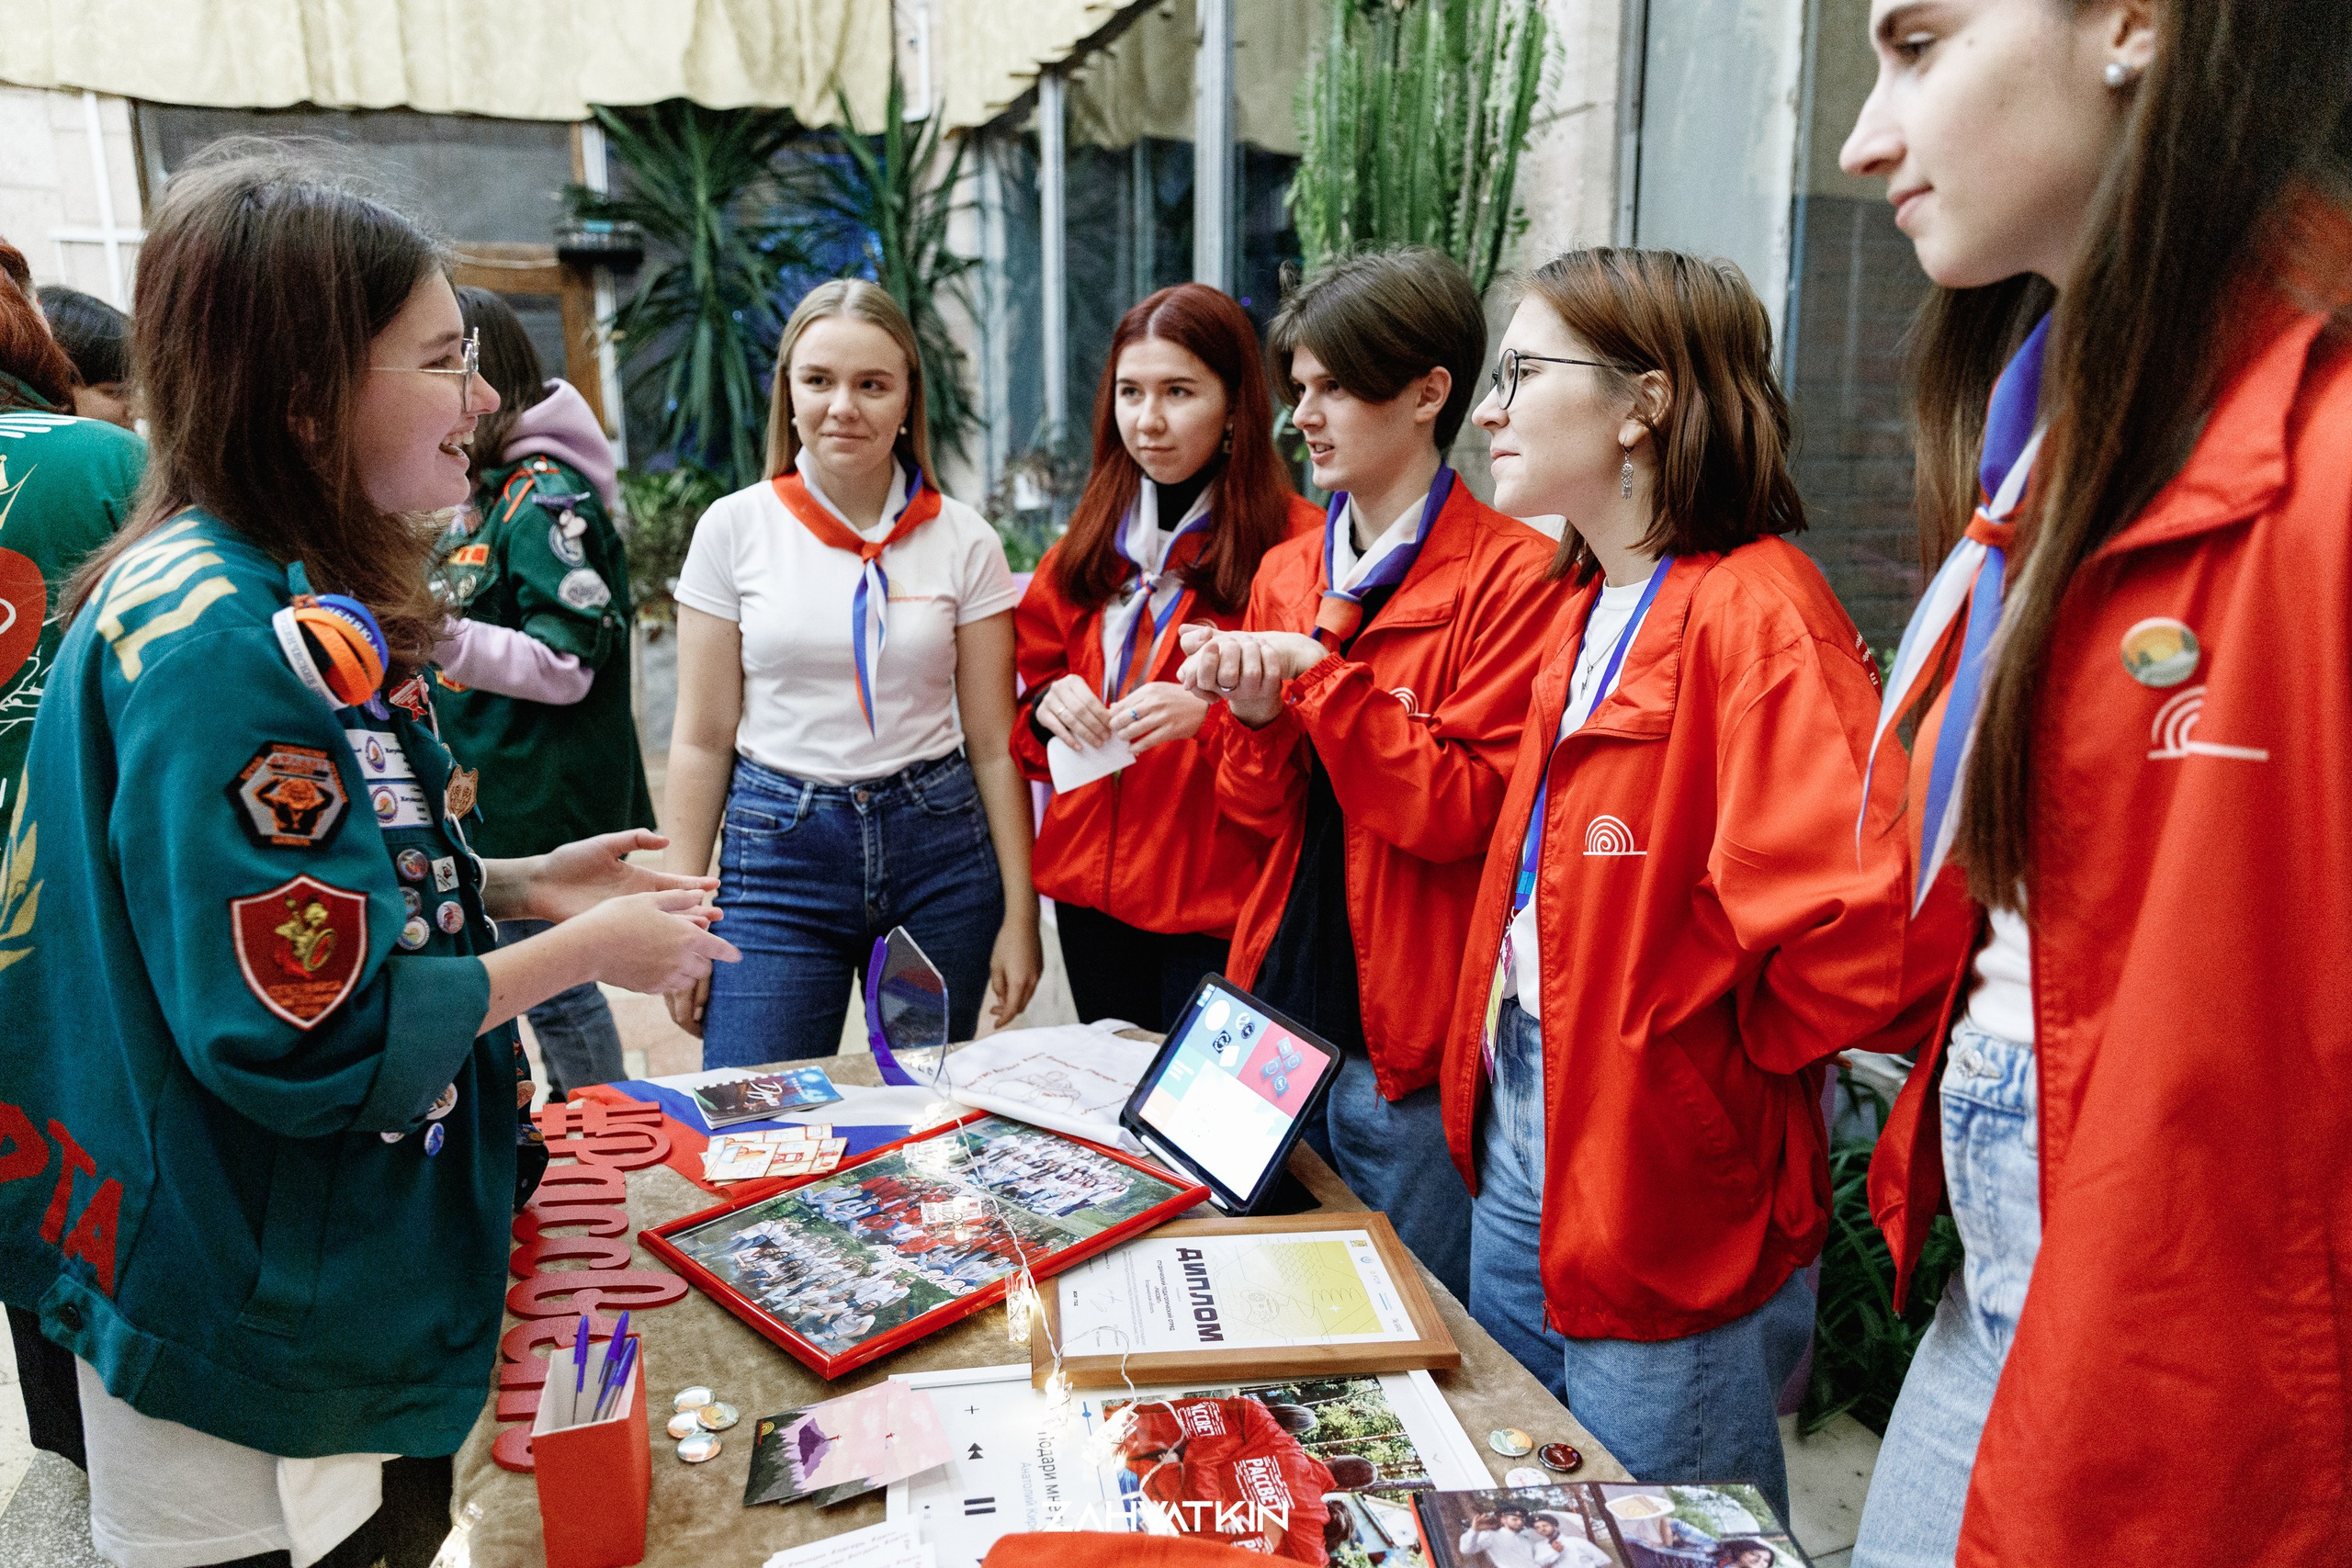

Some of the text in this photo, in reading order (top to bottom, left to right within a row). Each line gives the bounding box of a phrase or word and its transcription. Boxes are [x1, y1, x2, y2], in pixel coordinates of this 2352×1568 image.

[1176, 1248, 1225, 1342] ДИПЛОМ
[1036, 1432, 1057, 1481] Подари
[1020, 1461, 1036, 1506] Анатолий
[1246, 1458, 1283, 1511] РАССВЕТ
